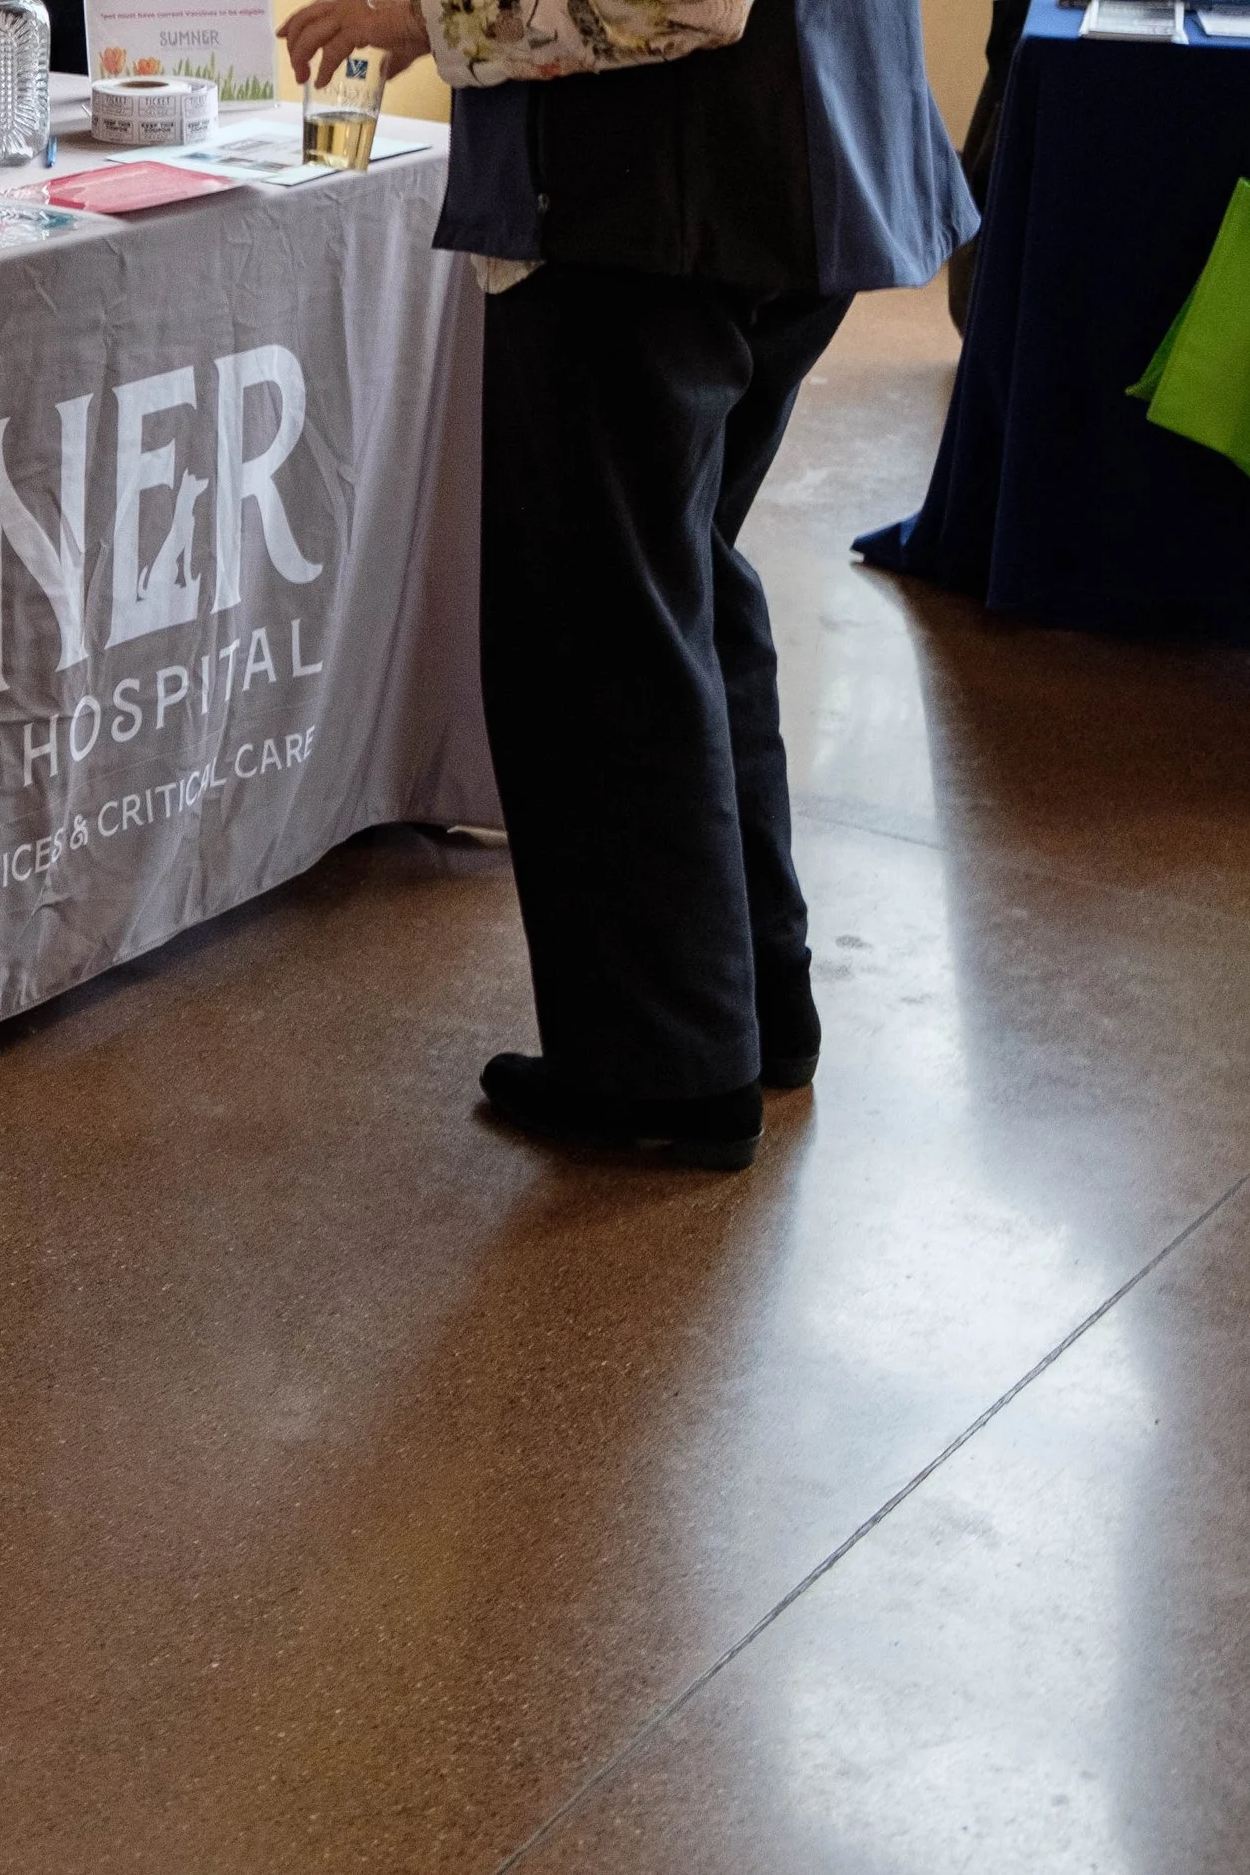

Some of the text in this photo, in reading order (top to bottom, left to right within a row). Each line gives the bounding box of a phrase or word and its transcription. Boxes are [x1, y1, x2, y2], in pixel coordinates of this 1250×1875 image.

[159, 30, 220, 47] SUMNER
[144, 95, 171, 105] TICKET
[23, 618, 324, 787] HOSPITAL
[69, 814, 89, 852] &
[97, 756, 227, 836] CRITICAL
[234, 726, 315, 780] CARE
